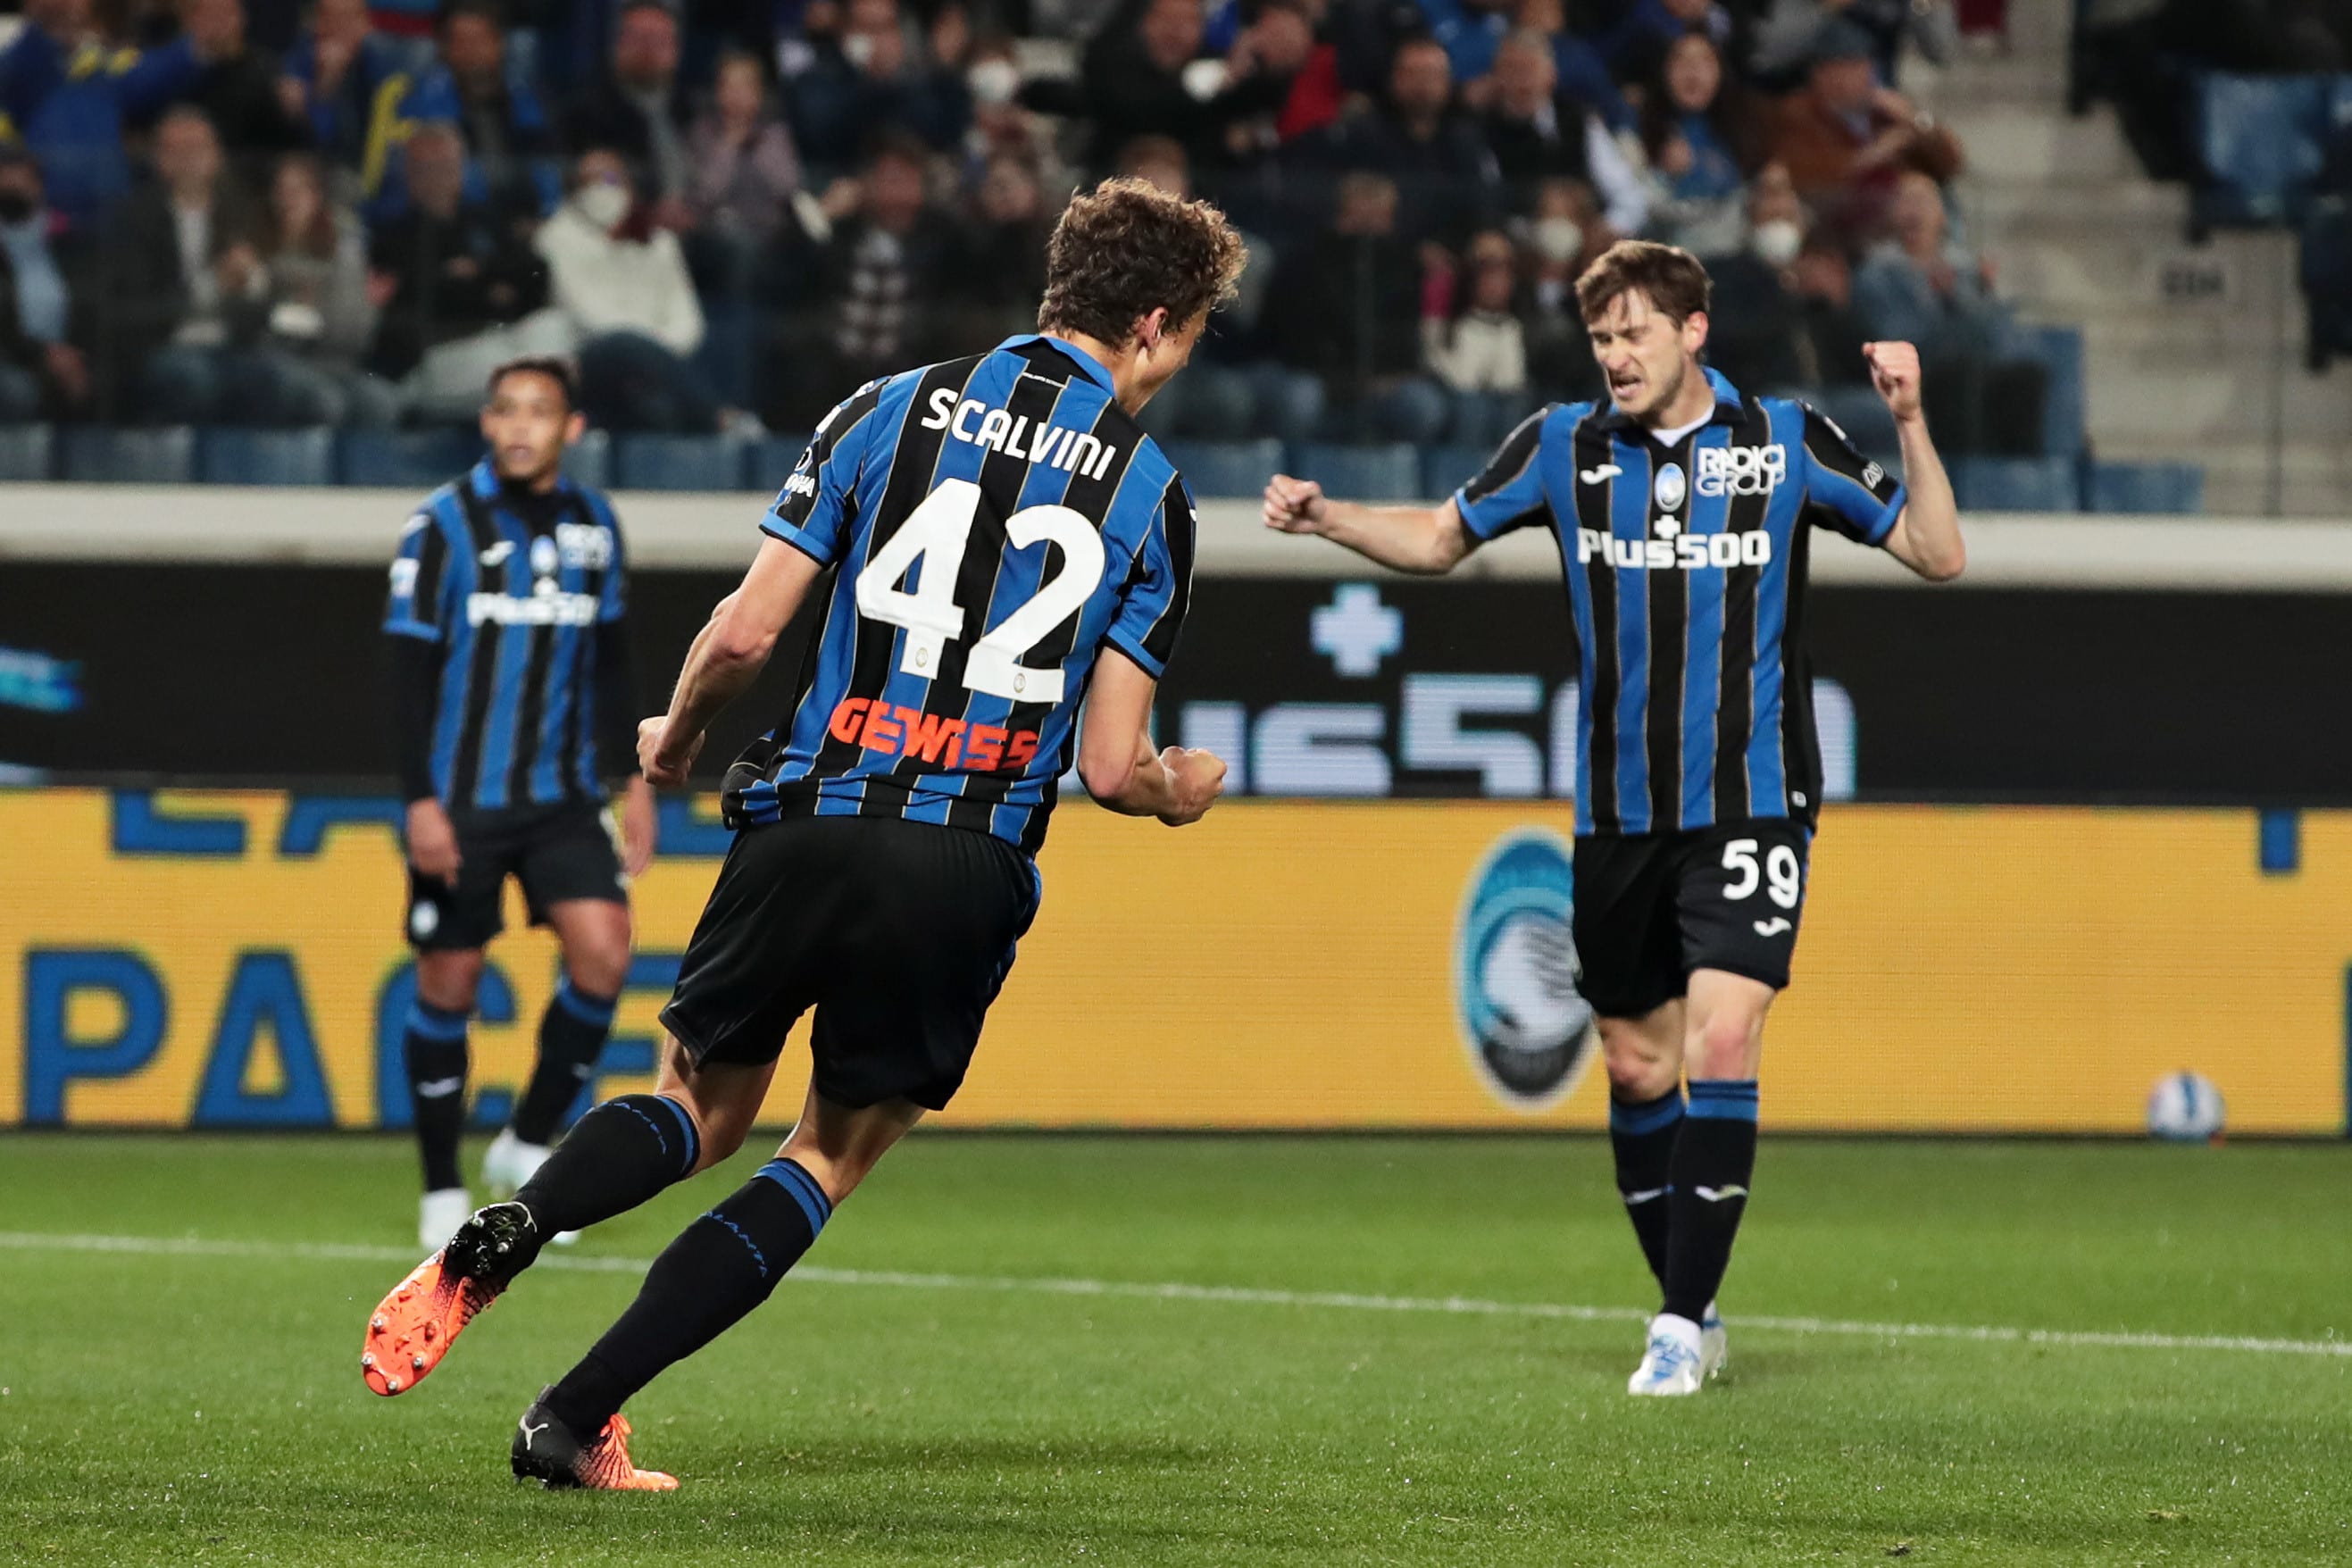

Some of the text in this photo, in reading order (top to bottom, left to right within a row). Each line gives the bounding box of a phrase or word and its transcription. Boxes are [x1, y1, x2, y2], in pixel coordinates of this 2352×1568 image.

[921, 387, 1117, 482] SCALVINI
[1695, 468, 1786, 496] GROUP
[1577, 528, 1772, 570] Plus500
[855, 476, 1106, 704] 42
[829, 696, 1040, 771] GEWISS
[1721, 838, 1800, 909] 59
